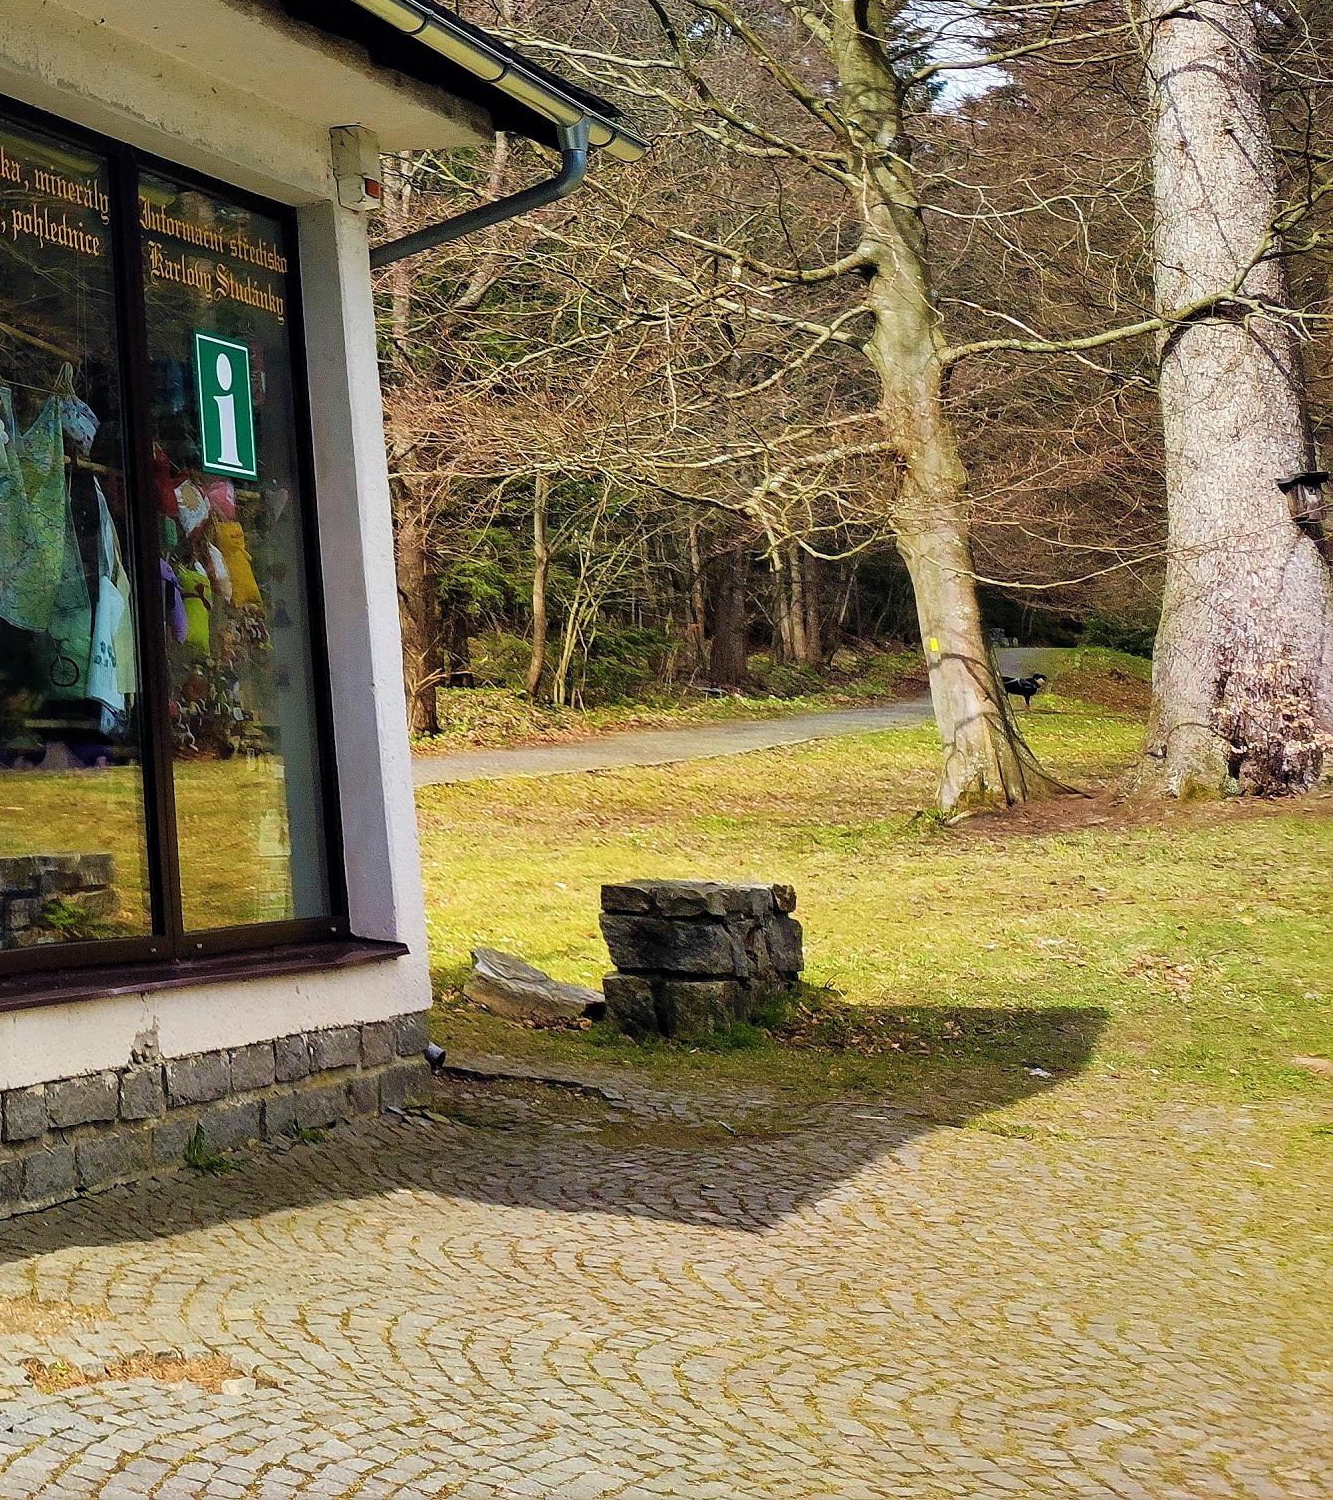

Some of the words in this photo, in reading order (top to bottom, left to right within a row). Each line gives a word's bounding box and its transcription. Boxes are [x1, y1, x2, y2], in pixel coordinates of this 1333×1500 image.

[35, 165, 110, 225] minerály
[12, 204, 100, 256] pohlednice
[138, 195, 224, 254] Informační
[229, 232, 288, 274] středisko
[148, 240, 213, 302] Karlovy
[213, 263, 285, 326] Studánky
